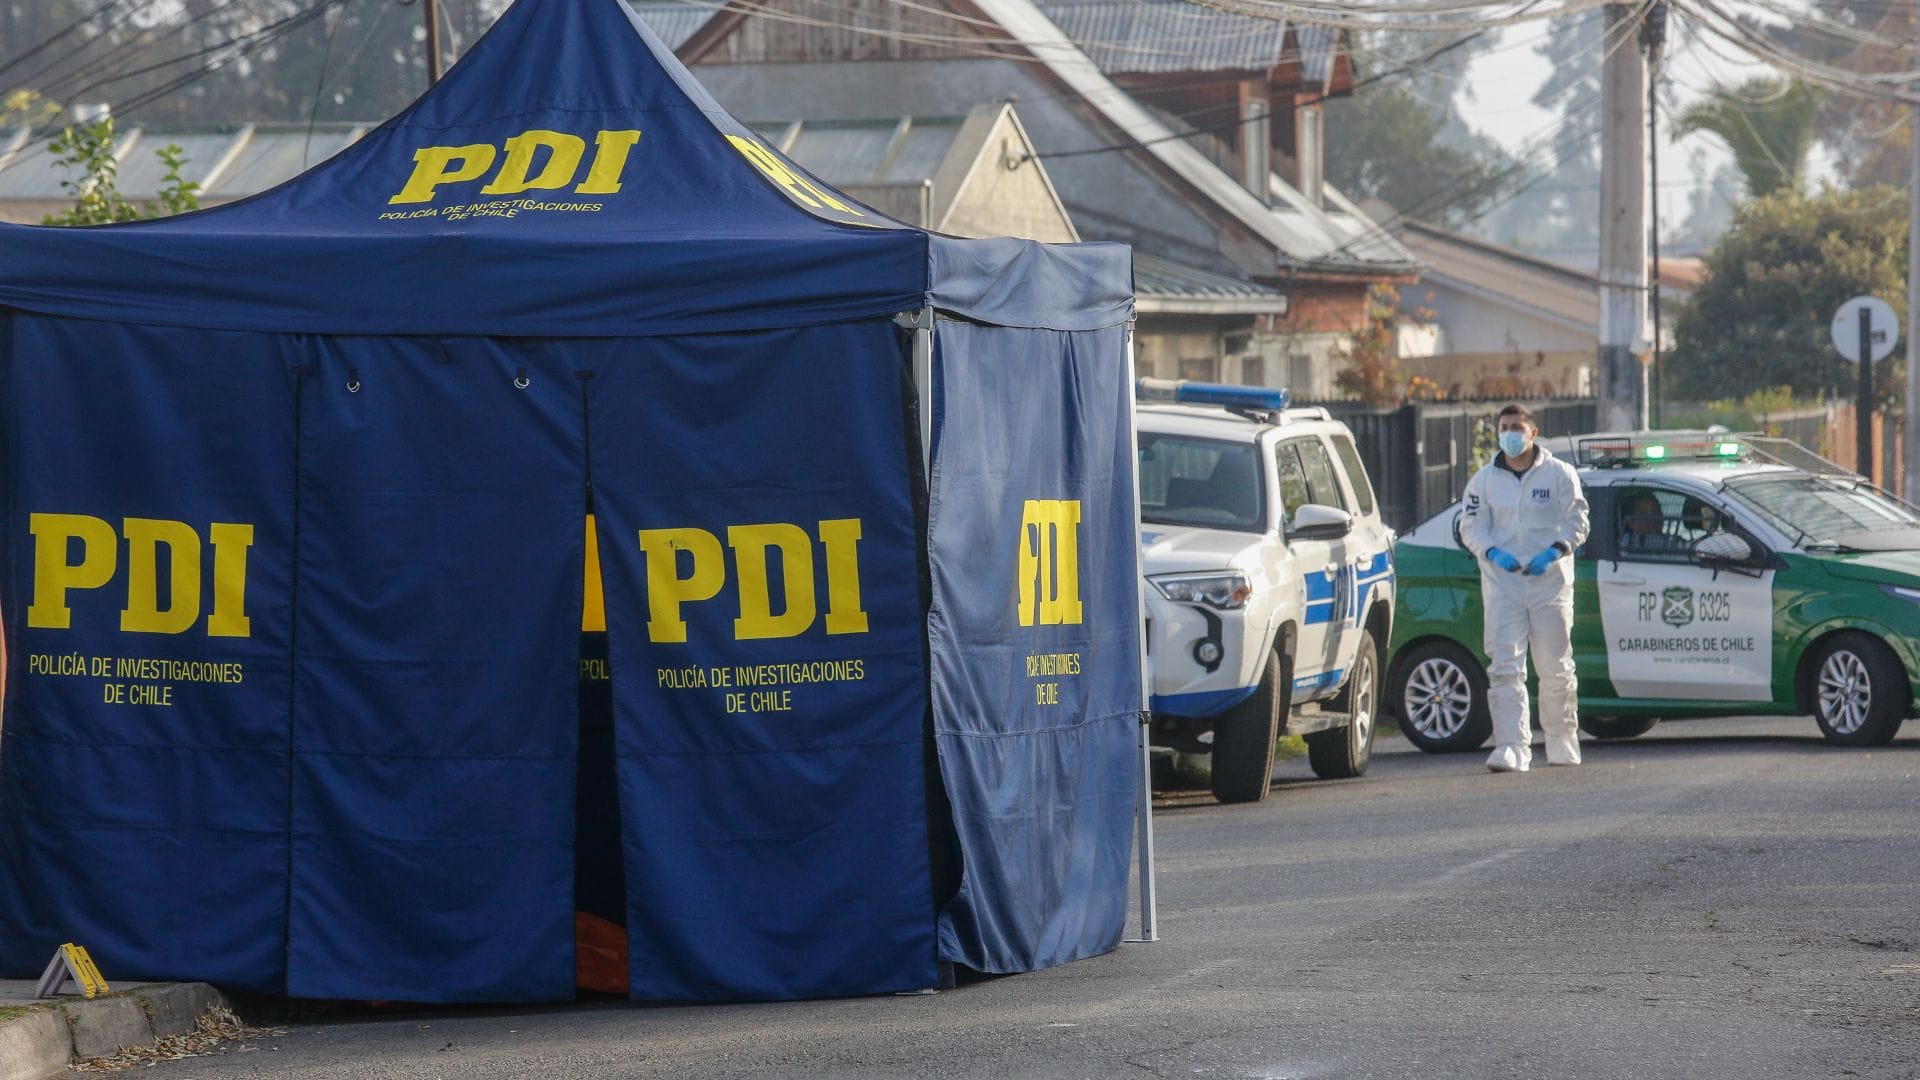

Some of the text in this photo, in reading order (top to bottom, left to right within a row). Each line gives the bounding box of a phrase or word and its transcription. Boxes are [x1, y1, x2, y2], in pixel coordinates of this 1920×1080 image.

[387, 129, 641, 204] PDI
[378, 199, 603, 220] POLICÍA DE INVESTIGACIONES
[447, 208, 519, 221] DE CHILE
[1532, 488, 1550, 498] PDI
[28, 512, 254, 637] PDI
[1018, 500, 1082, 626] PDI
[639, 518, 869, 643] PDI
[1638, 592, 1730, 622] RP 6325
[1619, 637, 1754, 651] CARABINEROS DE CHILE
[30, 652, 243, 683] POLICÍA DE INVESTIGACIONES
[658, 660, 864, 688] POLICÍA DE INVESTIGACIONES
[104, 684, 172, 705] DE CHILE
[726, 691, 791, 713] DE CHILE
